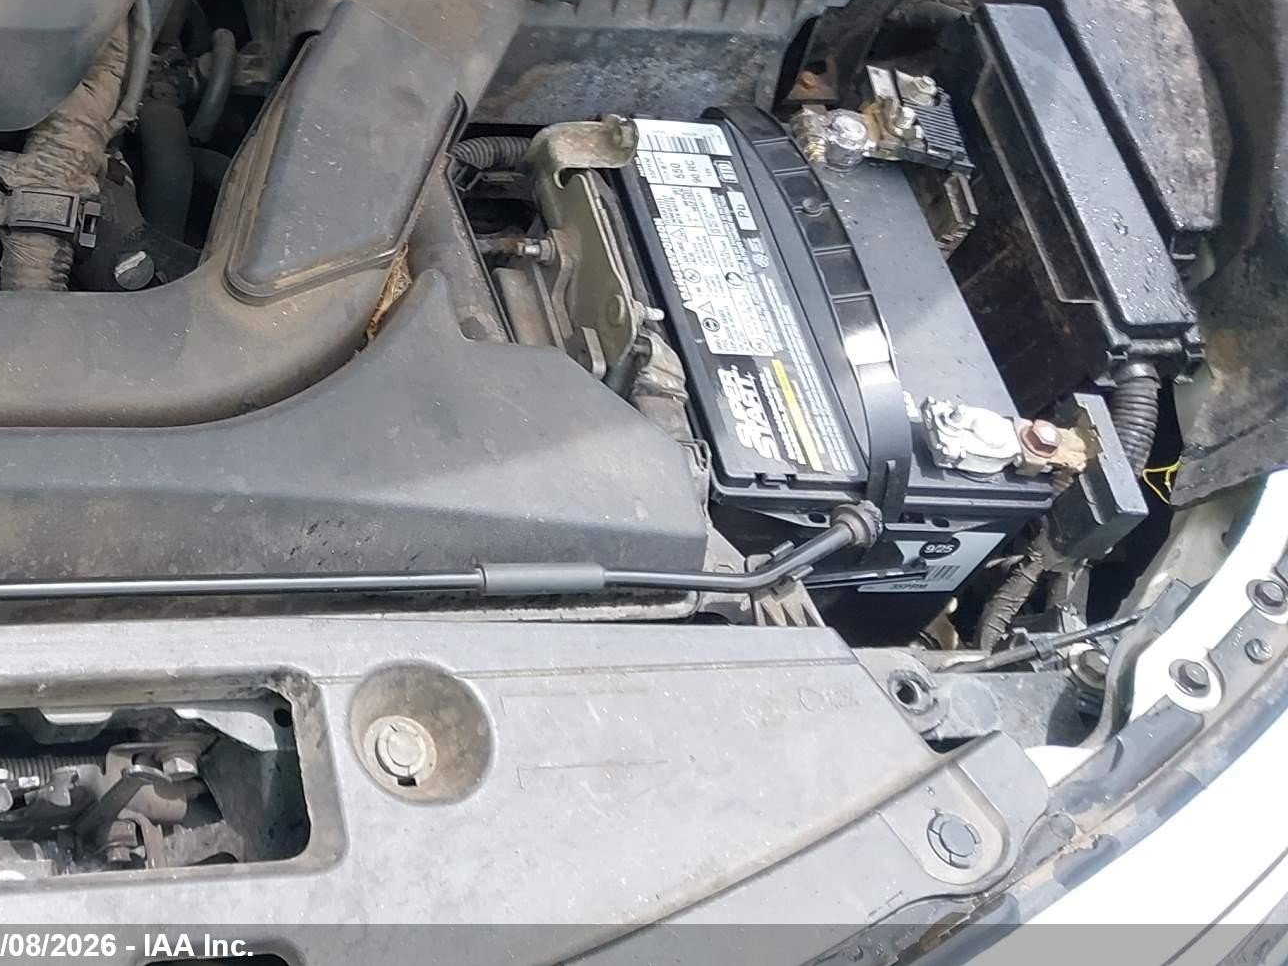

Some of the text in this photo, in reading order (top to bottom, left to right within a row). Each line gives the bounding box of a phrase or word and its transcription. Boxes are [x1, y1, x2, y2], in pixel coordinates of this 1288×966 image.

[717, 367, 754, 449] SUPER
[734, 370, 783, 462] START
[924, 544, 955, 554] 9/25
